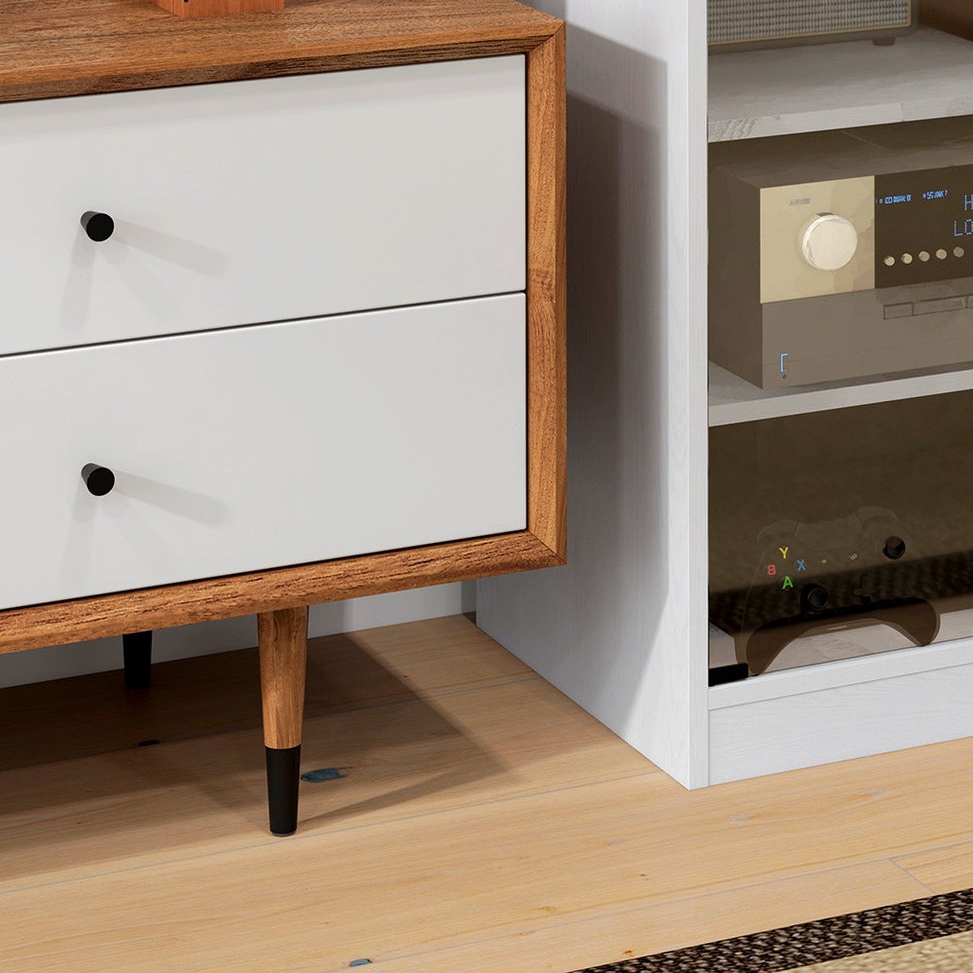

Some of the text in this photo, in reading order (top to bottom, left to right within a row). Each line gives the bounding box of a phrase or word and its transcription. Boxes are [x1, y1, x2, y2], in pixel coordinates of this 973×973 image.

[779, 547, 789, 559] Y
[797, 559, 806, 571] X
[782, 575, 793, 589] A
